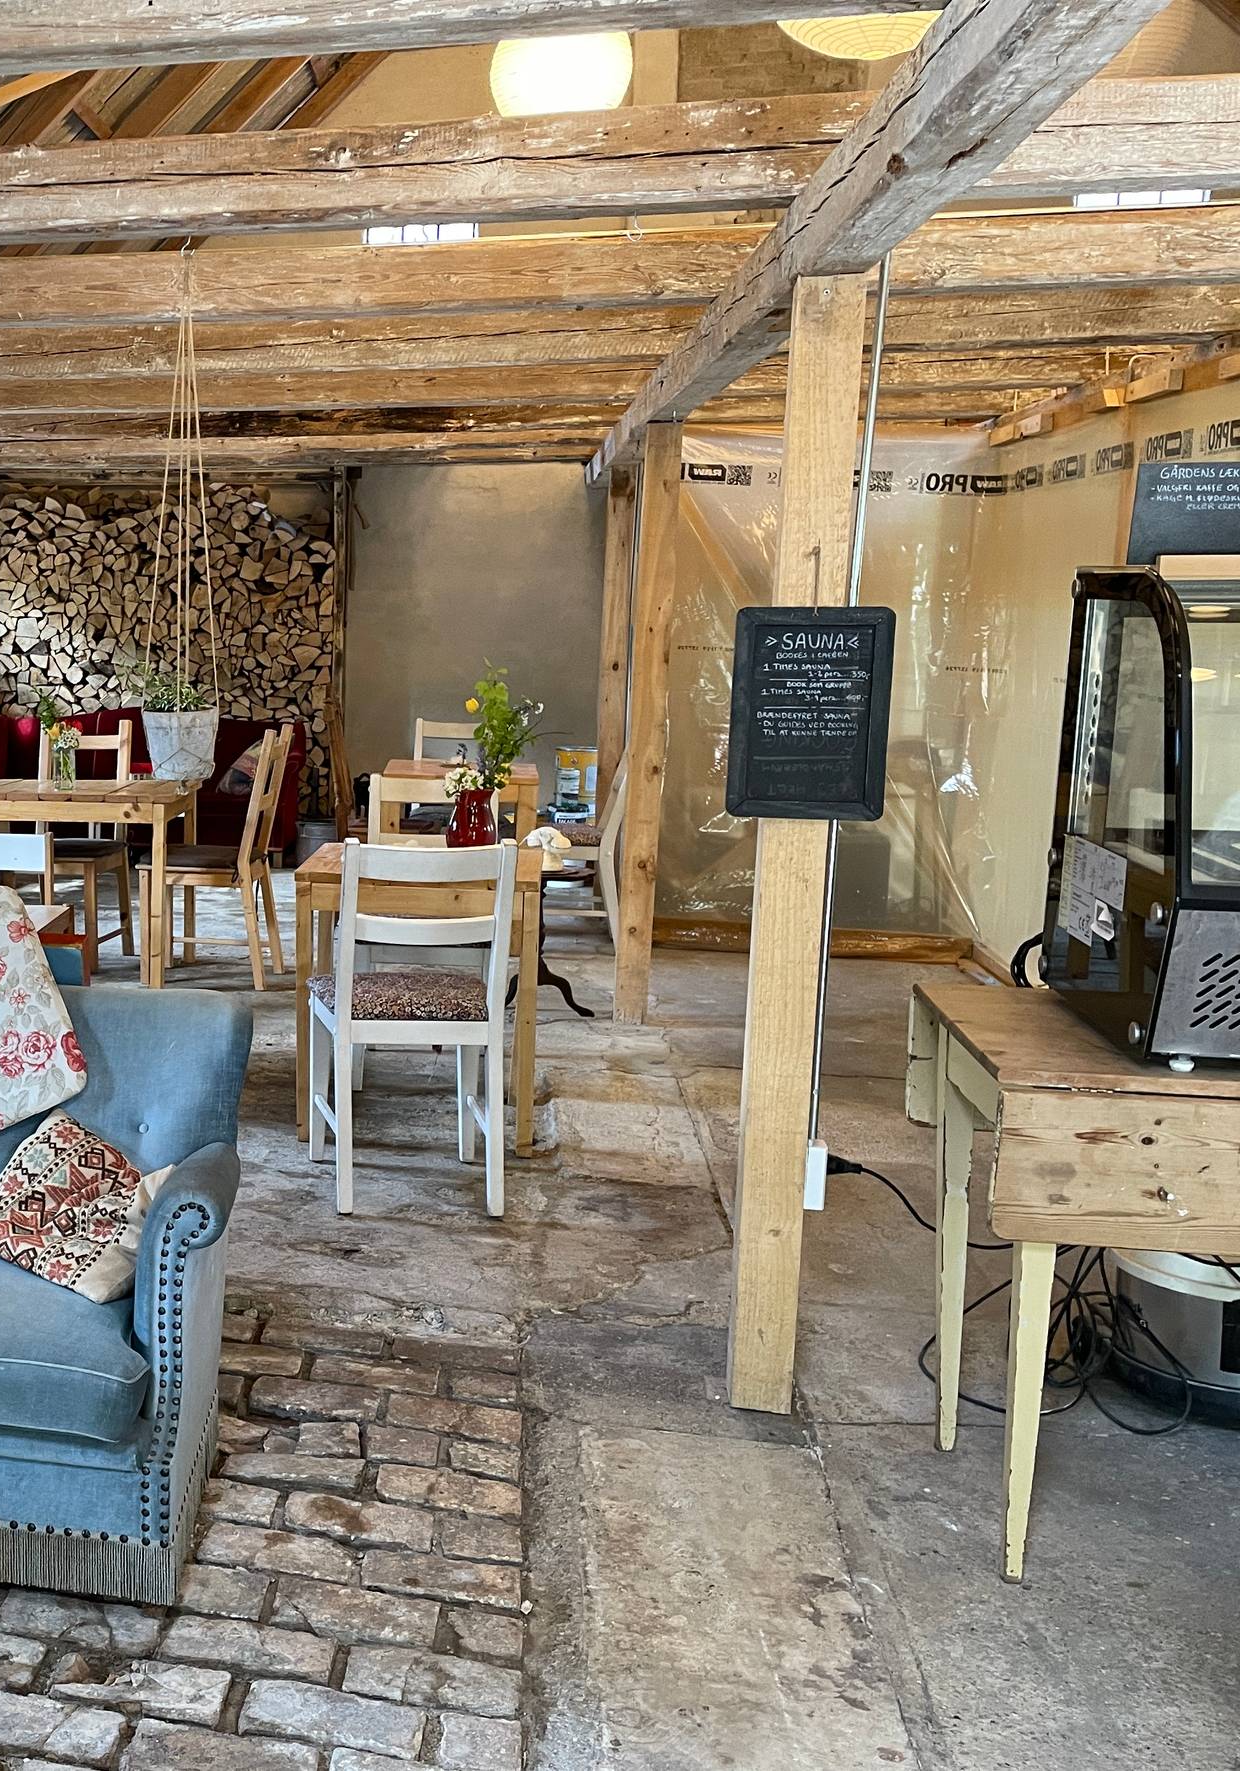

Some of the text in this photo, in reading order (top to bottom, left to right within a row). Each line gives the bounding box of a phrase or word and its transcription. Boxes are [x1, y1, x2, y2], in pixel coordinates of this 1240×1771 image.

[1160, 464, 1216, 480] GÅRDENS
[1196, 484, 1223, 493] KAFFE
[781, 632, 844, 650] SAUNA
[801, 663, 831, 671] SAUNA
